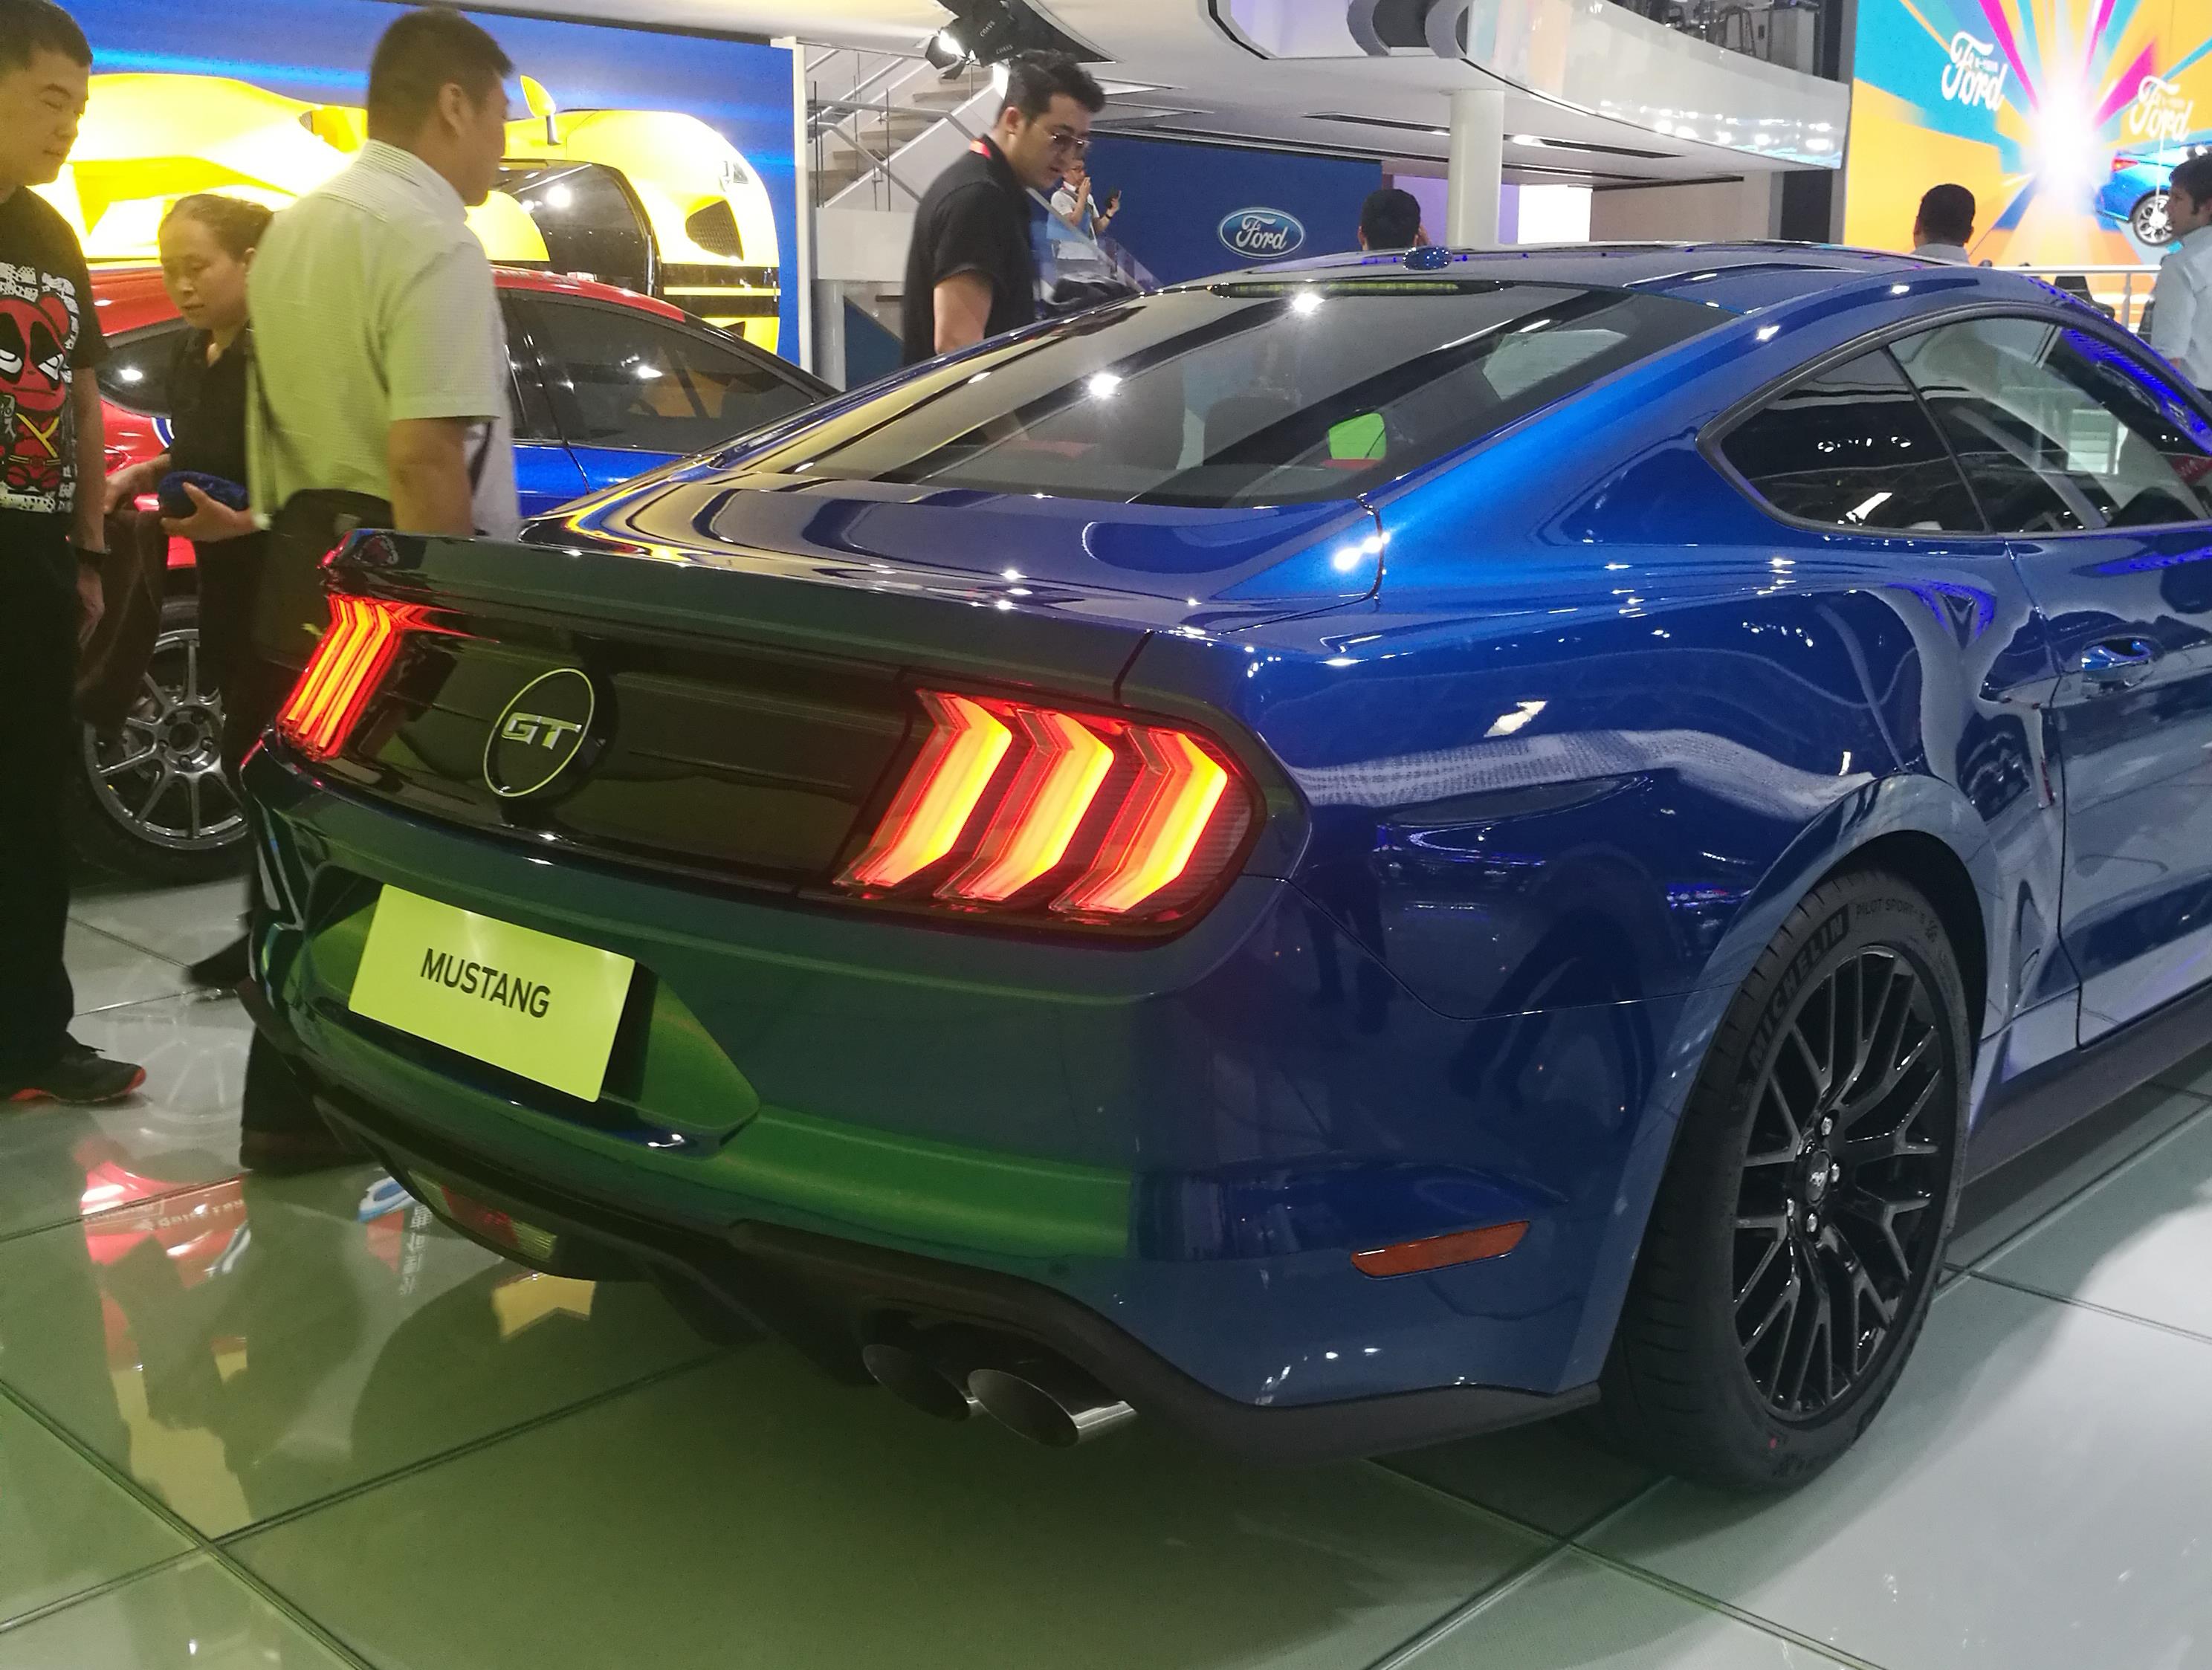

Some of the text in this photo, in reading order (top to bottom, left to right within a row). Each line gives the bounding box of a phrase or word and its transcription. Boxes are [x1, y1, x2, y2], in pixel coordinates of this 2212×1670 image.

[1941, 30, 2008, 111] Ford
[2129, 74, 2193, 142] Ford
[1236, 215, 1288, 250] Ford
[502, 712, 582, 750] GT
[420, 947, 552, 1019] MUSTANG
[1748, 913, 1844, 1072] MICHELIN
